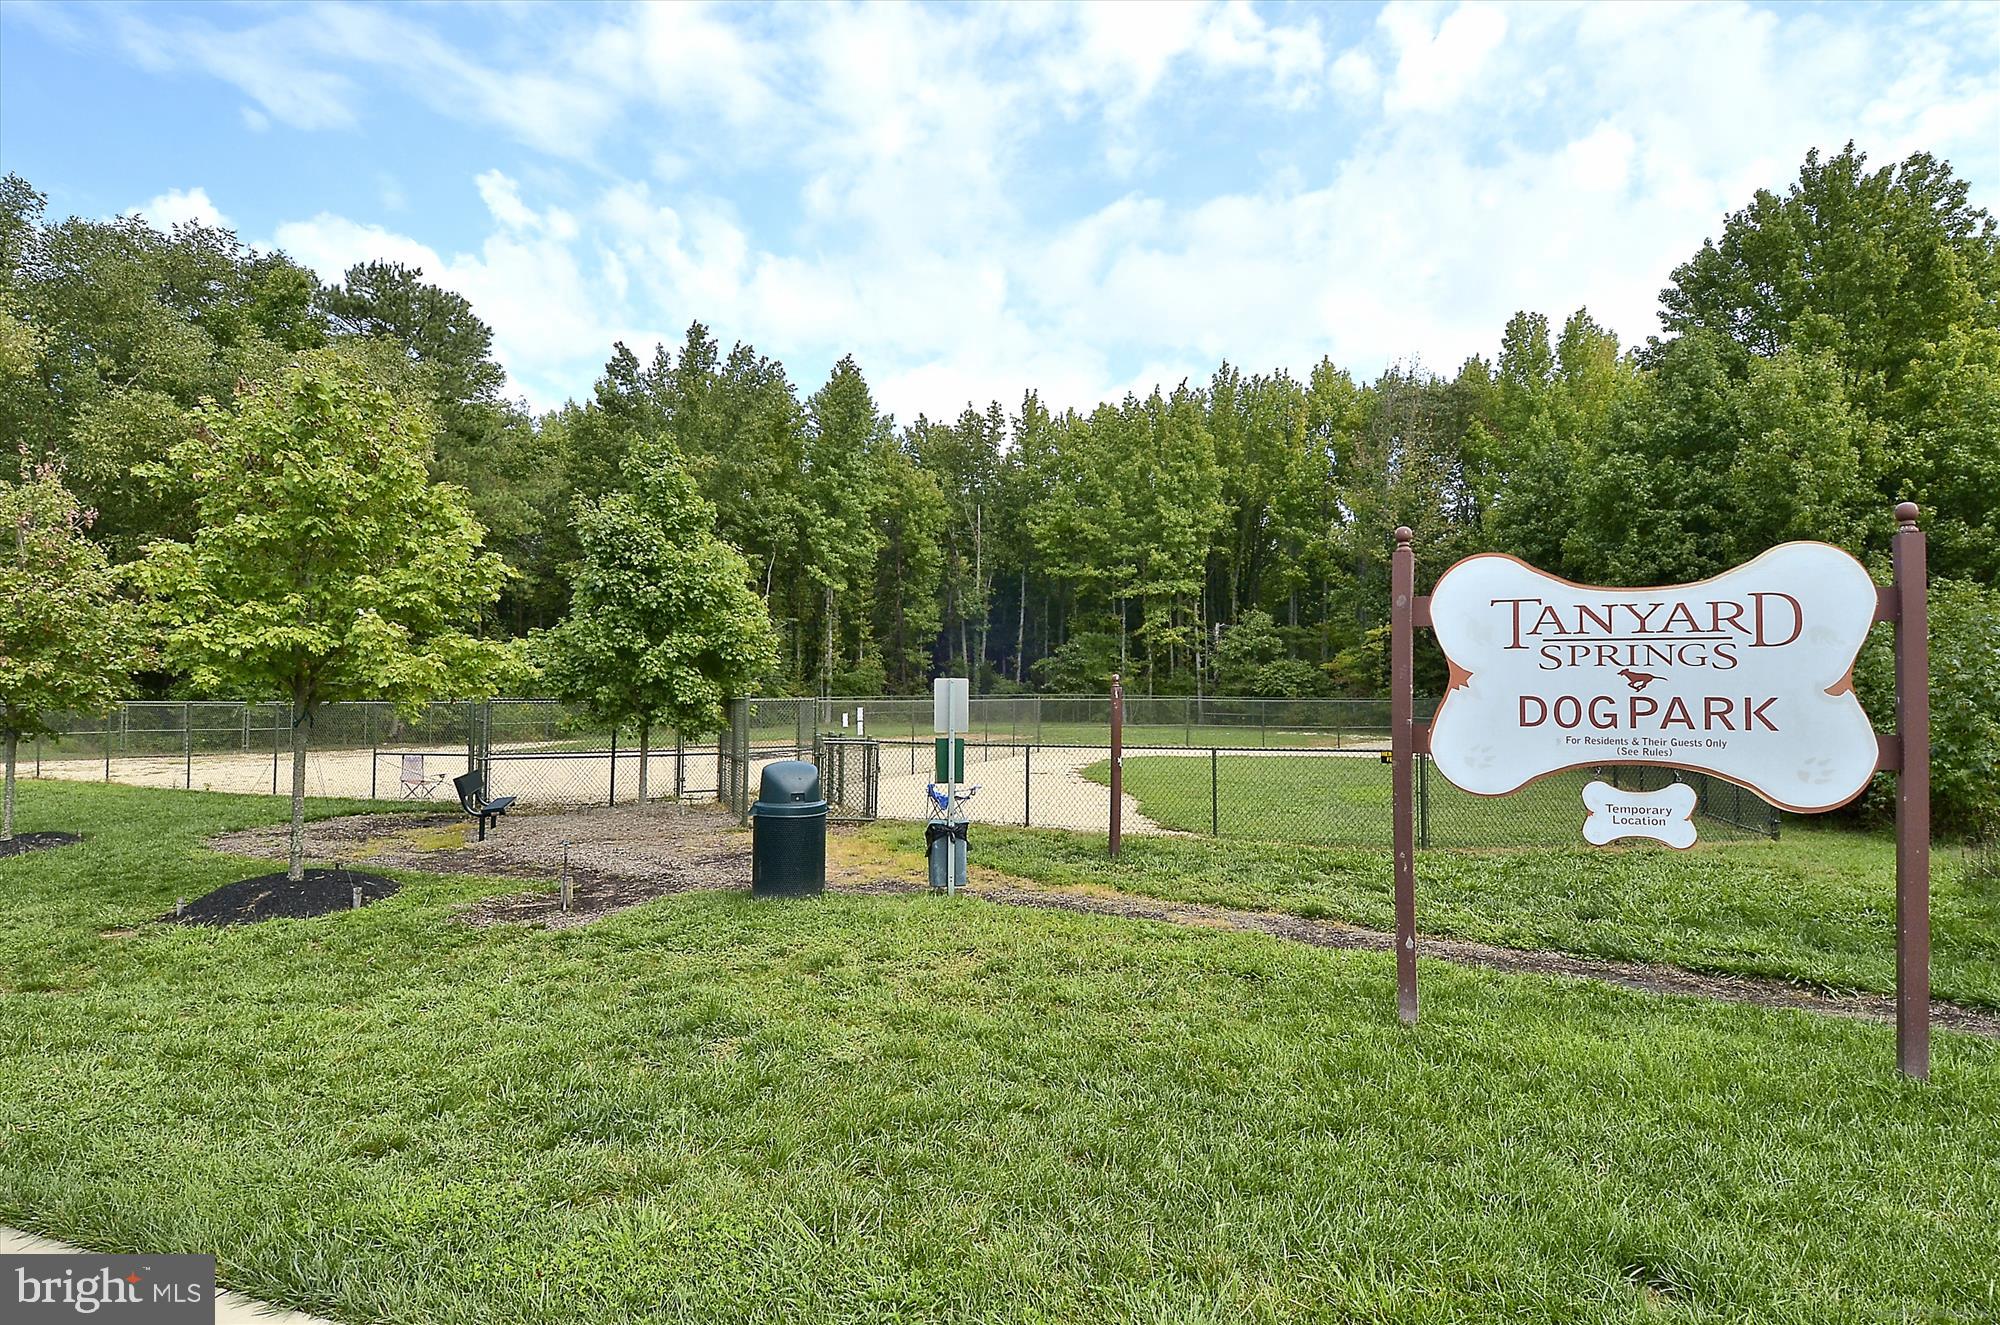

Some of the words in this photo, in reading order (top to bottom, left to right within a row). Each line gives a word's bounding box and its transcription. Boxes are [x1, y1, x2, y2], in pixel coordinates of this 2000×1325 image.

[1490, 592, 1803, 650] TANYARD
[1538, 642, 1738, 671] SPRINGS
[1565, 736, 1582, 745] For
[1584, 736, 1629, 746] Residents
[1631, 737, 1640, 746] &
[1642, 737, 1668, 747] Their
[1670, 738, 1703, 748] Guests
[1705, 739, 1728, 750] Only
[1616, 747, 1639, 757] (See
[1642, 748, 1673, 757] Rules)
[1605, 803, 1673, 818] Temporary
[1612, 815, 1667, 827] Location
